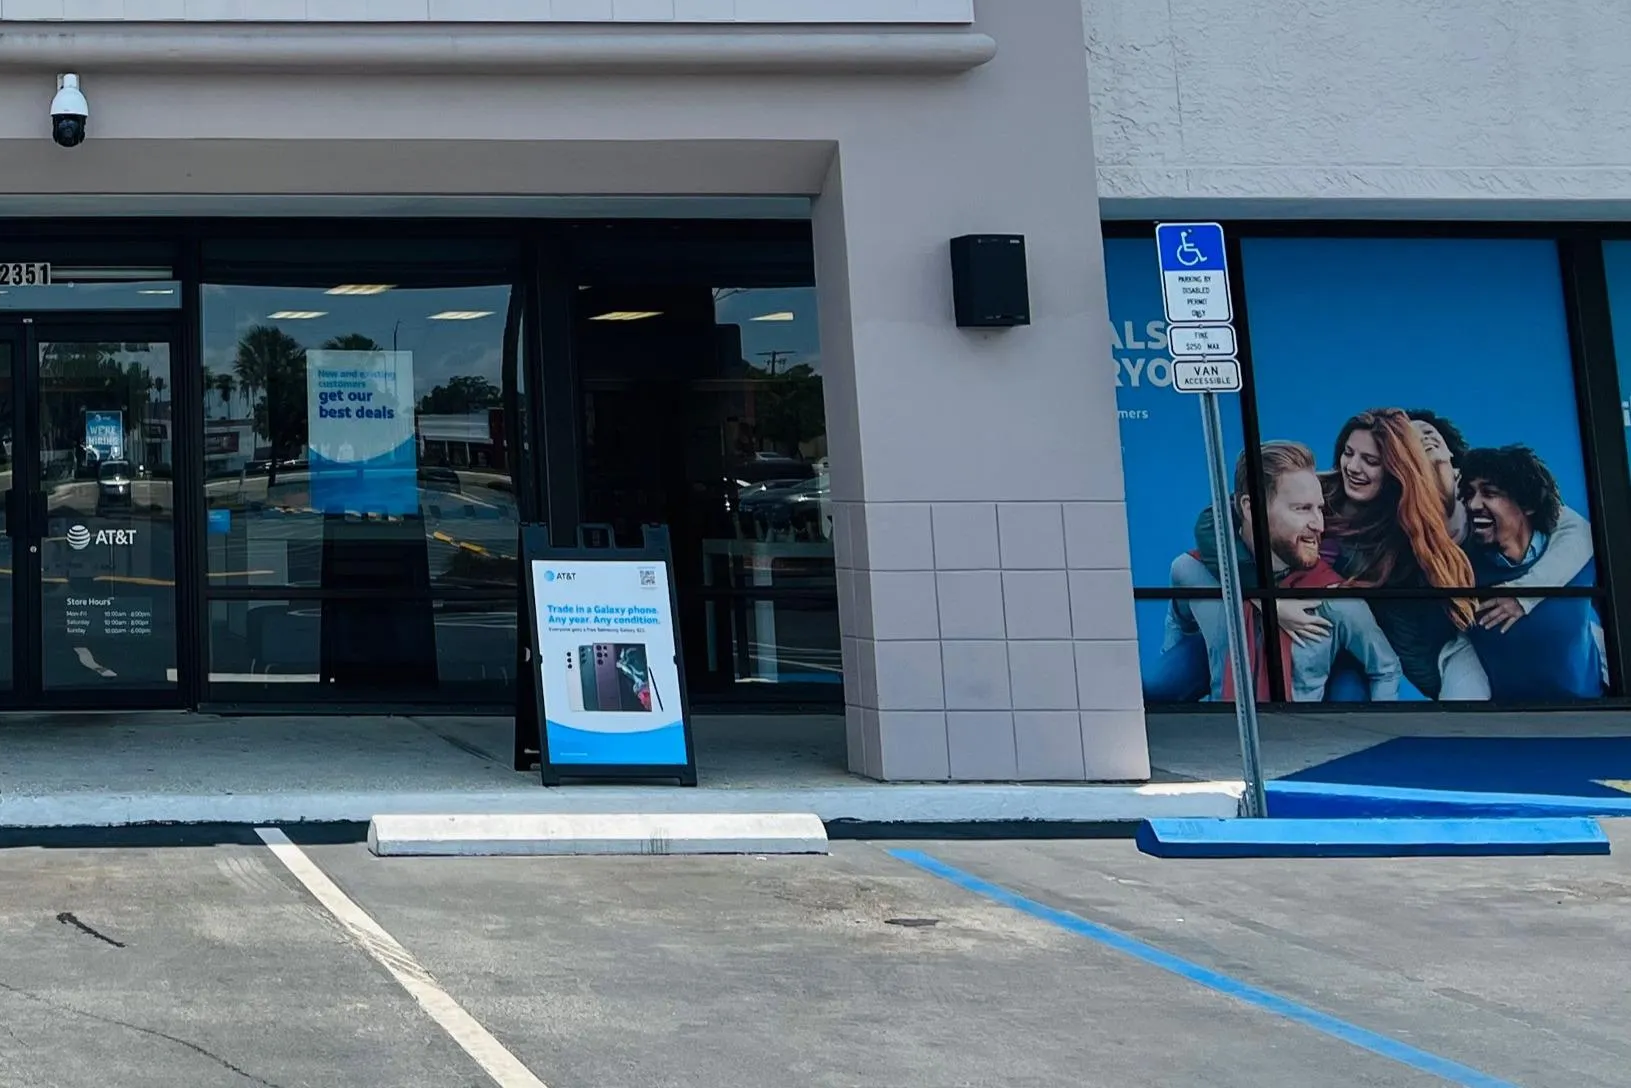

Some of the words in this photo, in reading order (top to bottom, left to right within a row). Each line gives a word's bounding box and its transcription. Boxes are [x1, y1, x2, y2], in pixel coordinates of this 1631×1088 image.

[0, 264, 48, 285] 2351
[339, 369, 357, 378] and
[1194, 366, 1219, 375] VAN
[318, 380, 366, 388] customers
[1184, 377, 1231, 385] ACCESSIBLE
[318, 390, 344, 405] get
[348, 392, 373, 402] our
[319, 406, 352, 419] best
[355, 406, 395, 419] deals
[95, 530, 136, 545] AT&T
[556, 572, 576, 580] AT&T
[67, 598, 87, 606] Store
[88, 598, 111, 606] Hours
[547, 604, 574, 613] Trade
[576, 605, 585, 613] in
[594, 605, 626, 616] Galaxy
[549, 615, 566, 625] Any
[593, 616, 612, 625] Any
